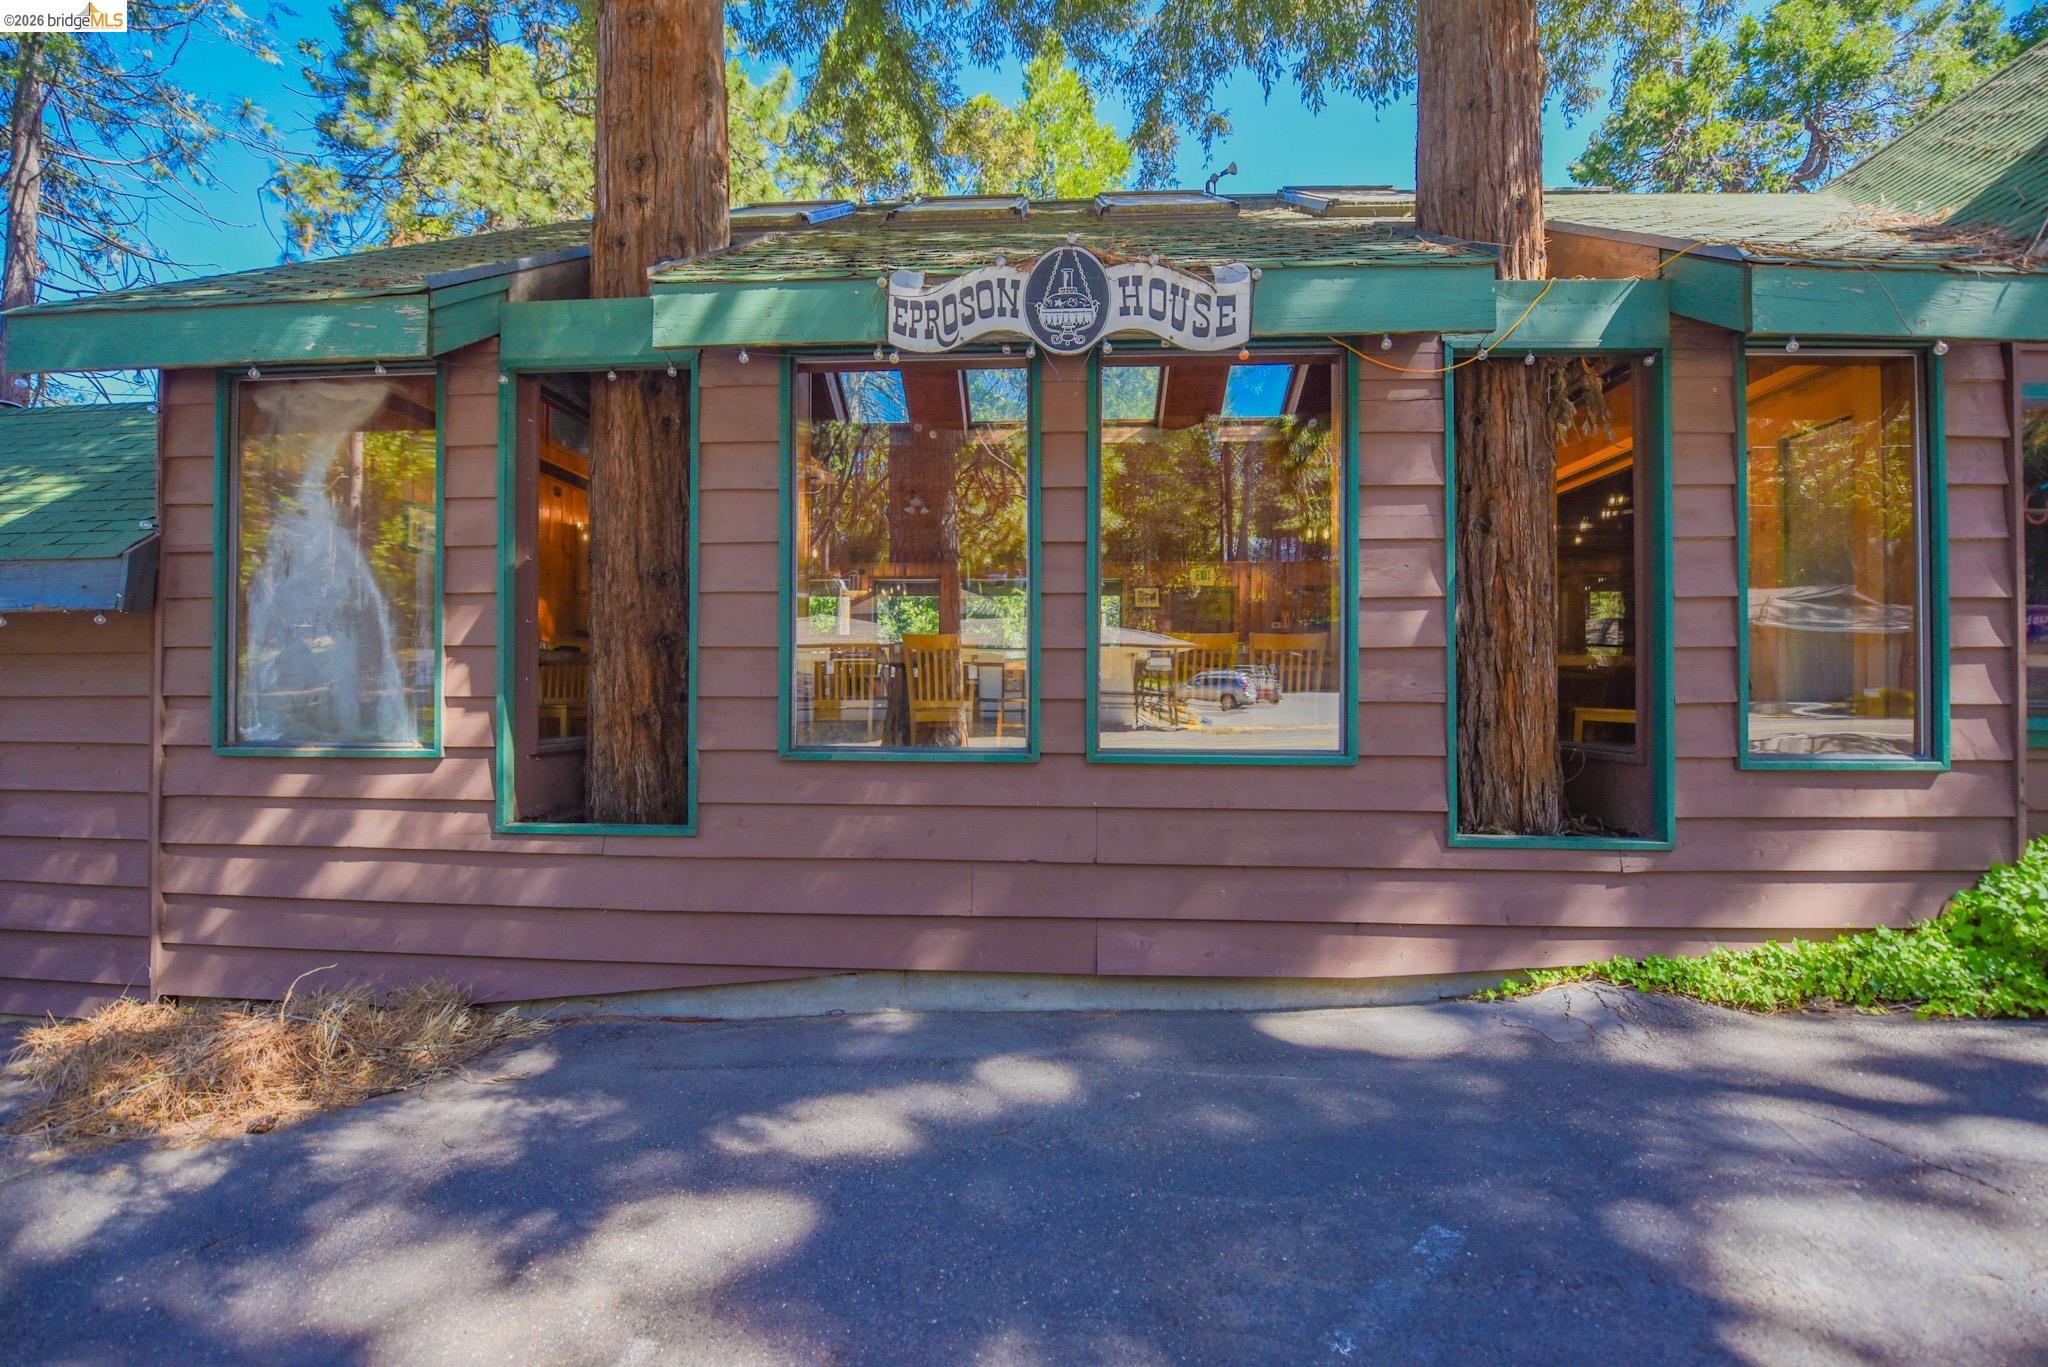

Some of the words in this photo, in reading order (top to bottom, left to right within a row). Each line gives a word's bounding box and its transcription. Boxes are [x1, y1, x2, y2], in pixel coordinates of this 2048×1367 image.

[893, 278, 1020, 347] EPROSON
[1118, 275, 1236, 337] HOUSE
[1195, 569, 1211, 581] EXIT
